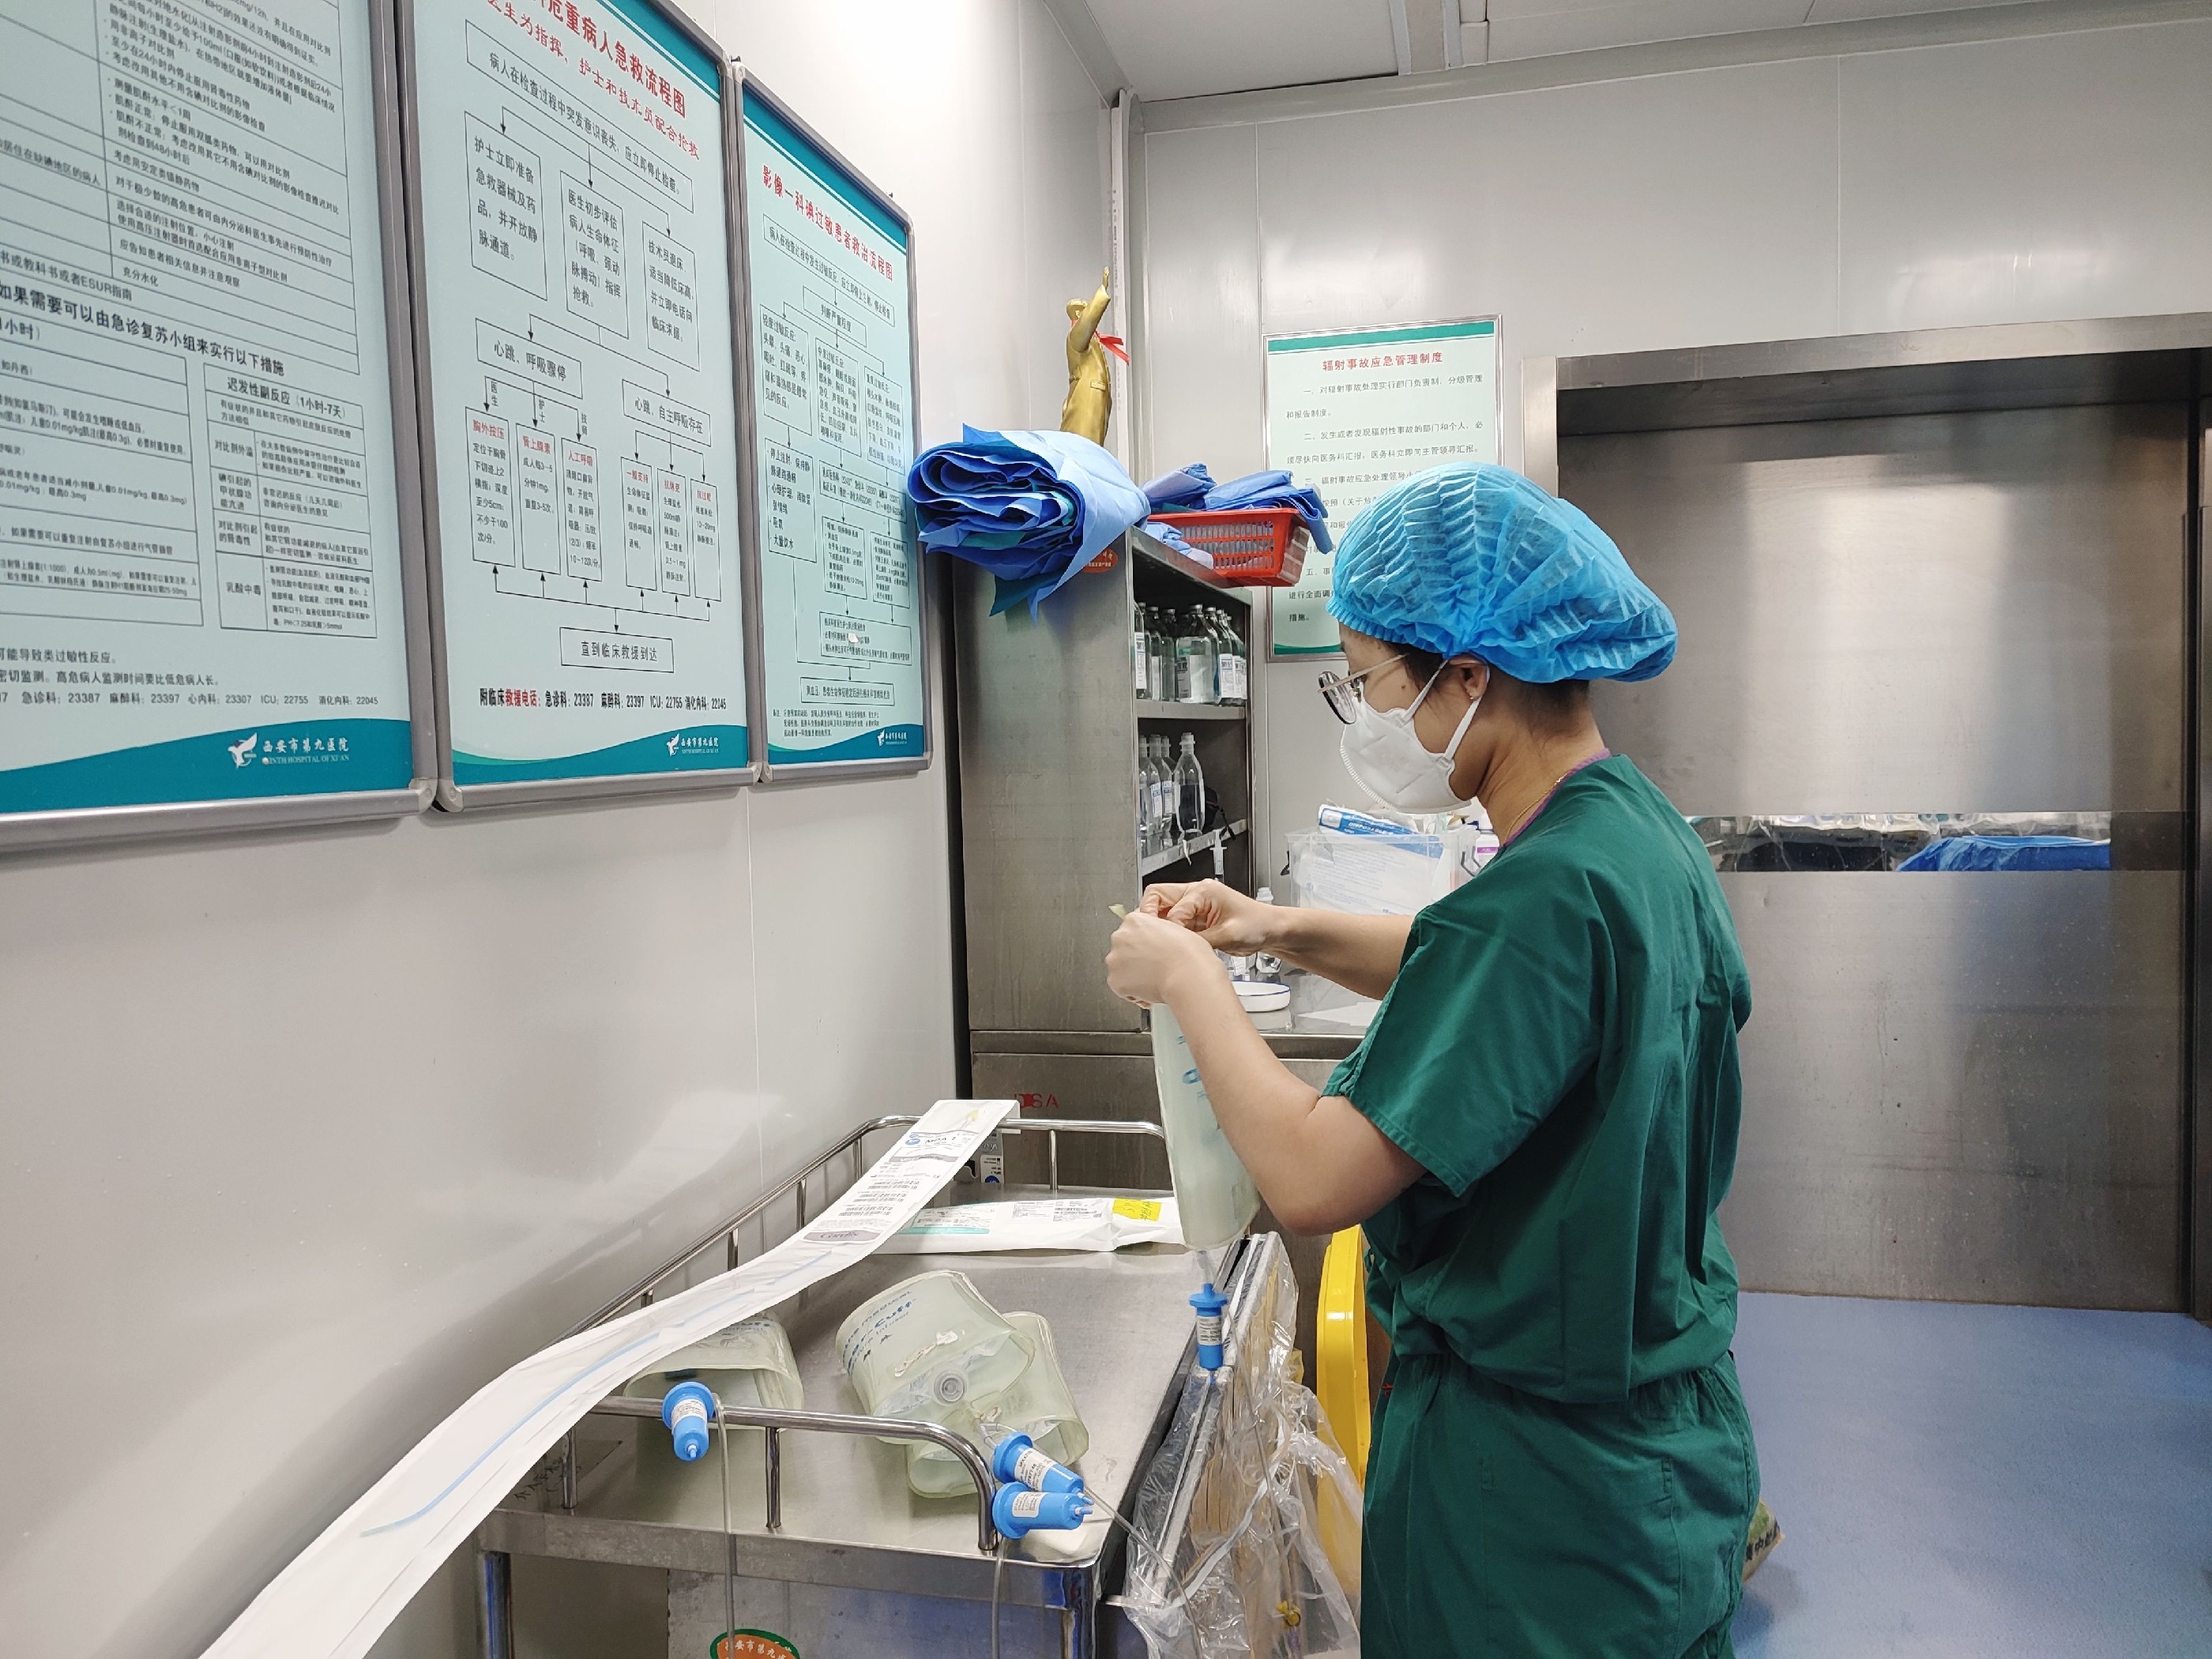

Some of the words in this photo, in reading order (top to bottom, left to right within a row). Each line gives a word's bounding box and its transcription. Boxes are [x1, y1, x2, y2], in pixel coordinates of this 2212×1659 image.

[540, 0, 686, 118] 危重病人急救流程图
[475, 135, 534, 185] 护士立即准备
[476, 167, 536, 215] 急救器械及药
[568, 188, 619, 231] 医生初步评估
[569, 214, 619, 254] 病人生命体征
[762, 165, 893, 282] 影像一科碘过敏患者救治流程图
[123, 266, 159, 288] 充分水化
[1322, 352, 1443, 372] 辐射事故应急管理制度
[1288, 590, 1334, 600] 进行全面调
[581, 640, 658, 662] 直到临床救援到达
